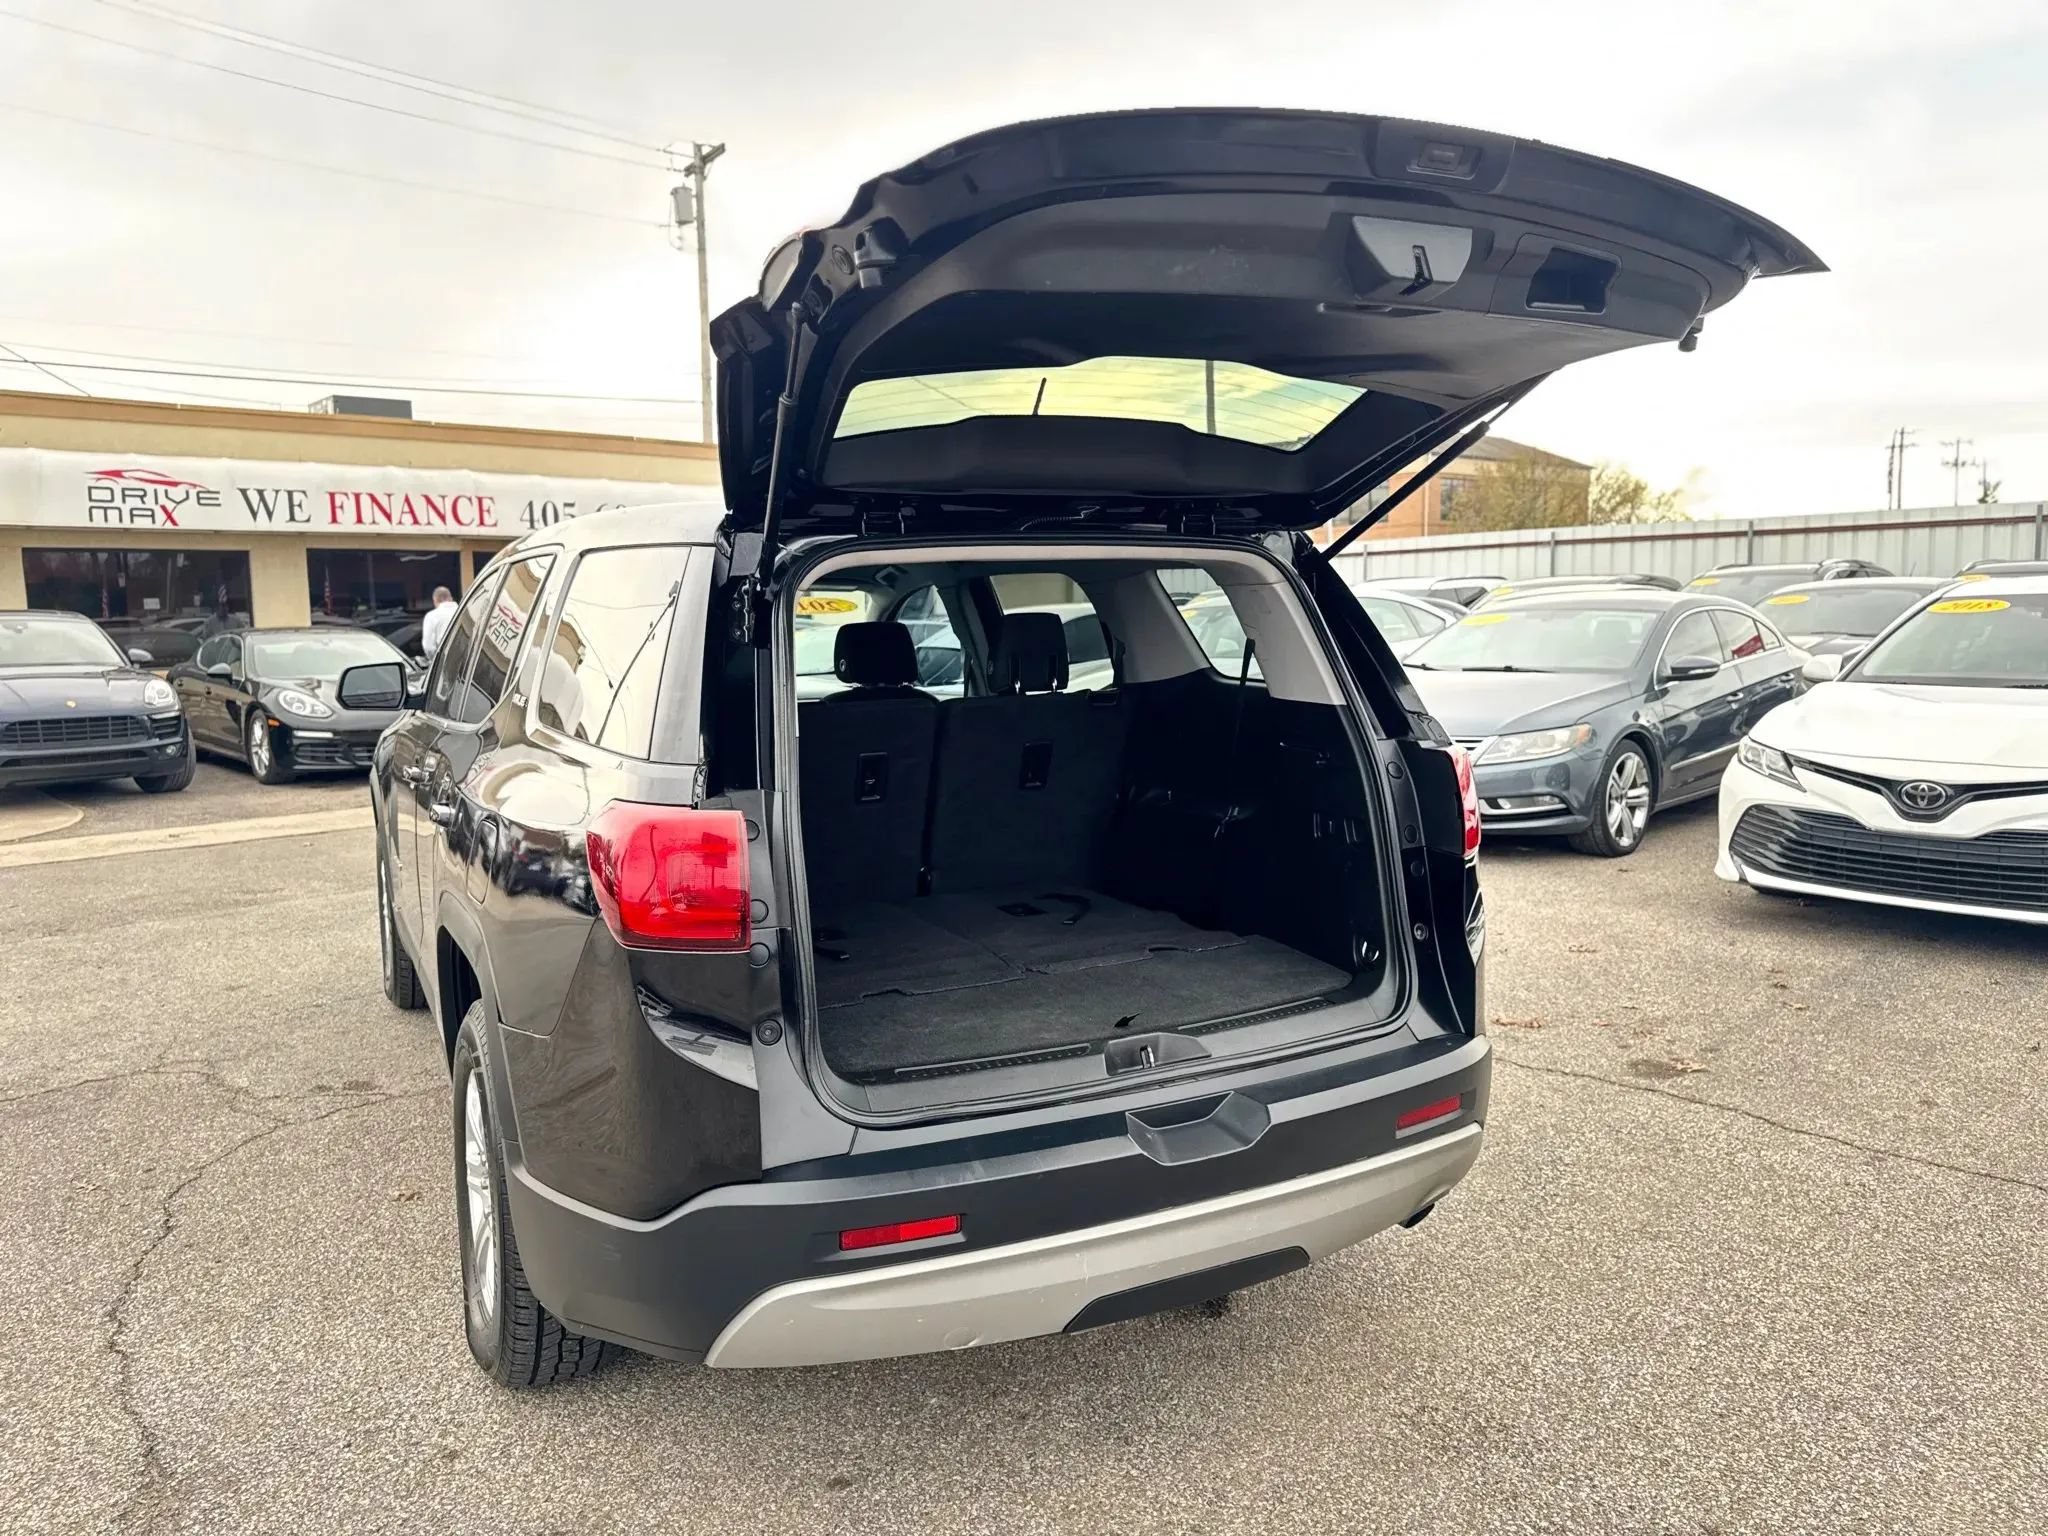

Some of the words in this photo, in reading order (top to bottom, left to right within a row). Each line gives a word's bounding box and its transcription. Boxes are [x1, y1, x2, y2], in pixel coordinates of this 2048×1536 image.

[88, 486, 221, 507] DRIVE
[88, 505, 179, 526] MAX
[237, 488, 312, 523] WE
[326, 491, 498, 527] FINANCE
